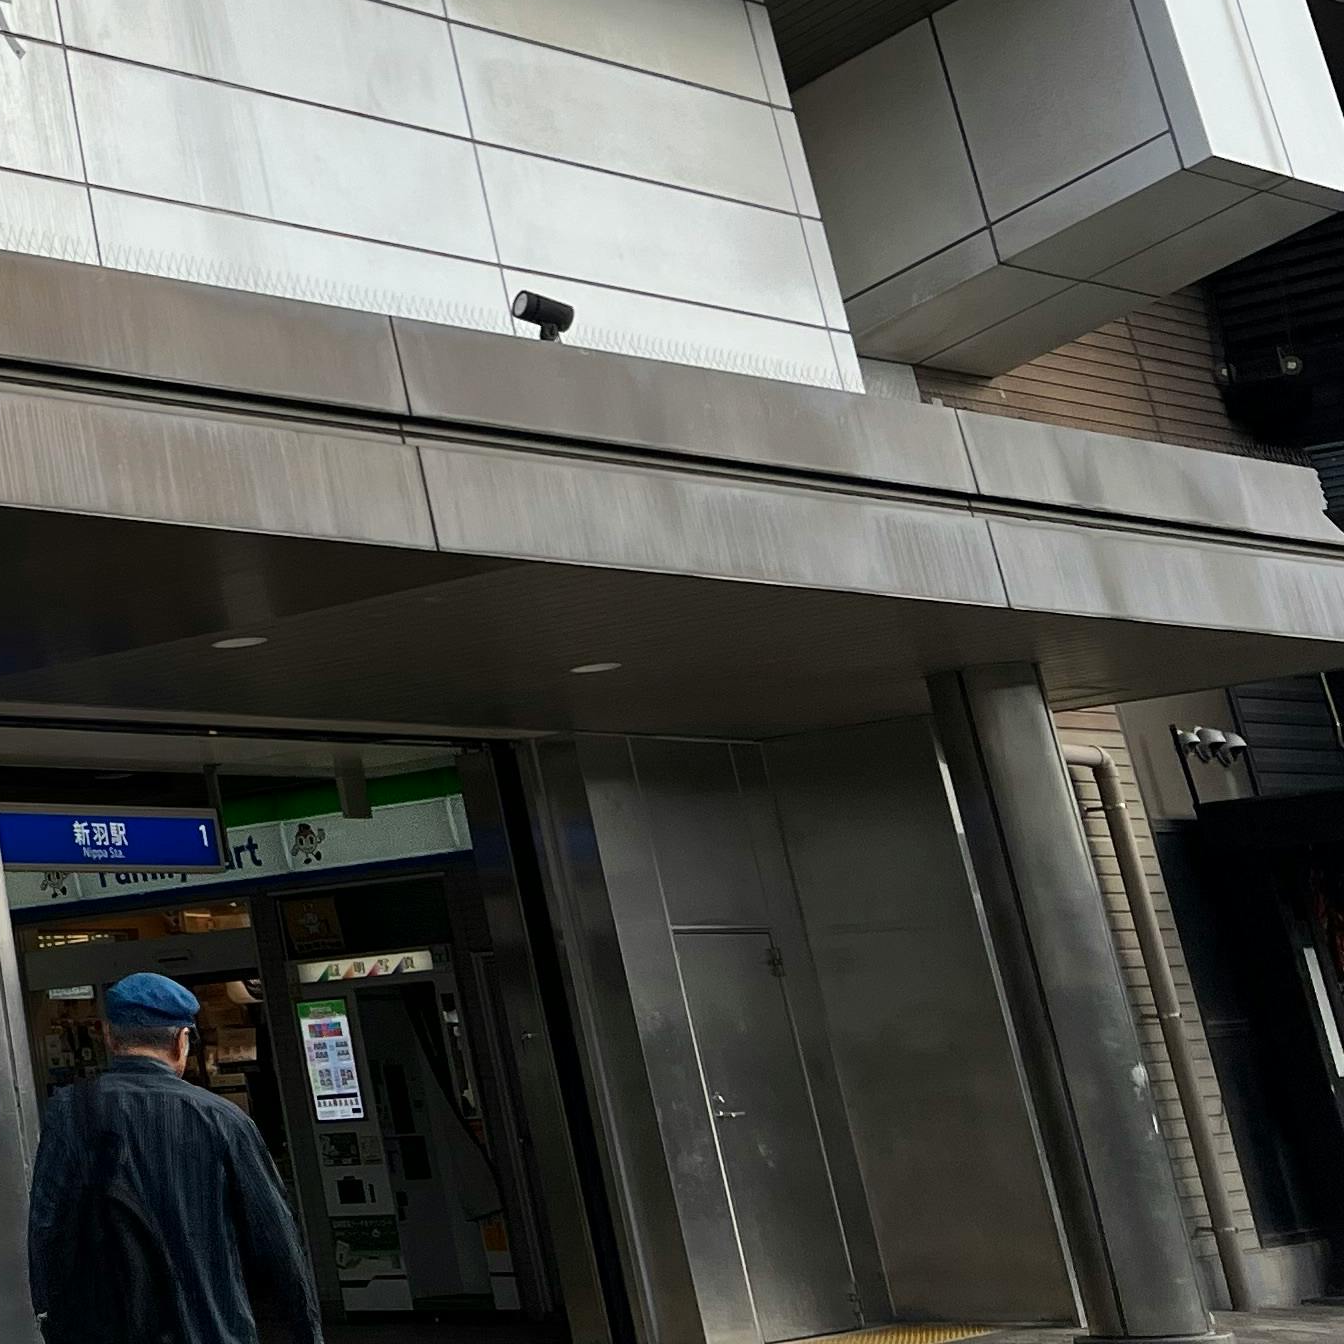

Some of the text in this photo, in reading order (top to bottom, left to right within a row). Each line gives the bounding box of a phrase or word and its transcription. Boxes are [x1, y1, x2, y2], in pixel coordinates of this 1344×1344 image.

[73, 820, 128, 846] 新羽駅
[199, 824, 209, 847] 1
[82, 846, 108, 860] Nippa
